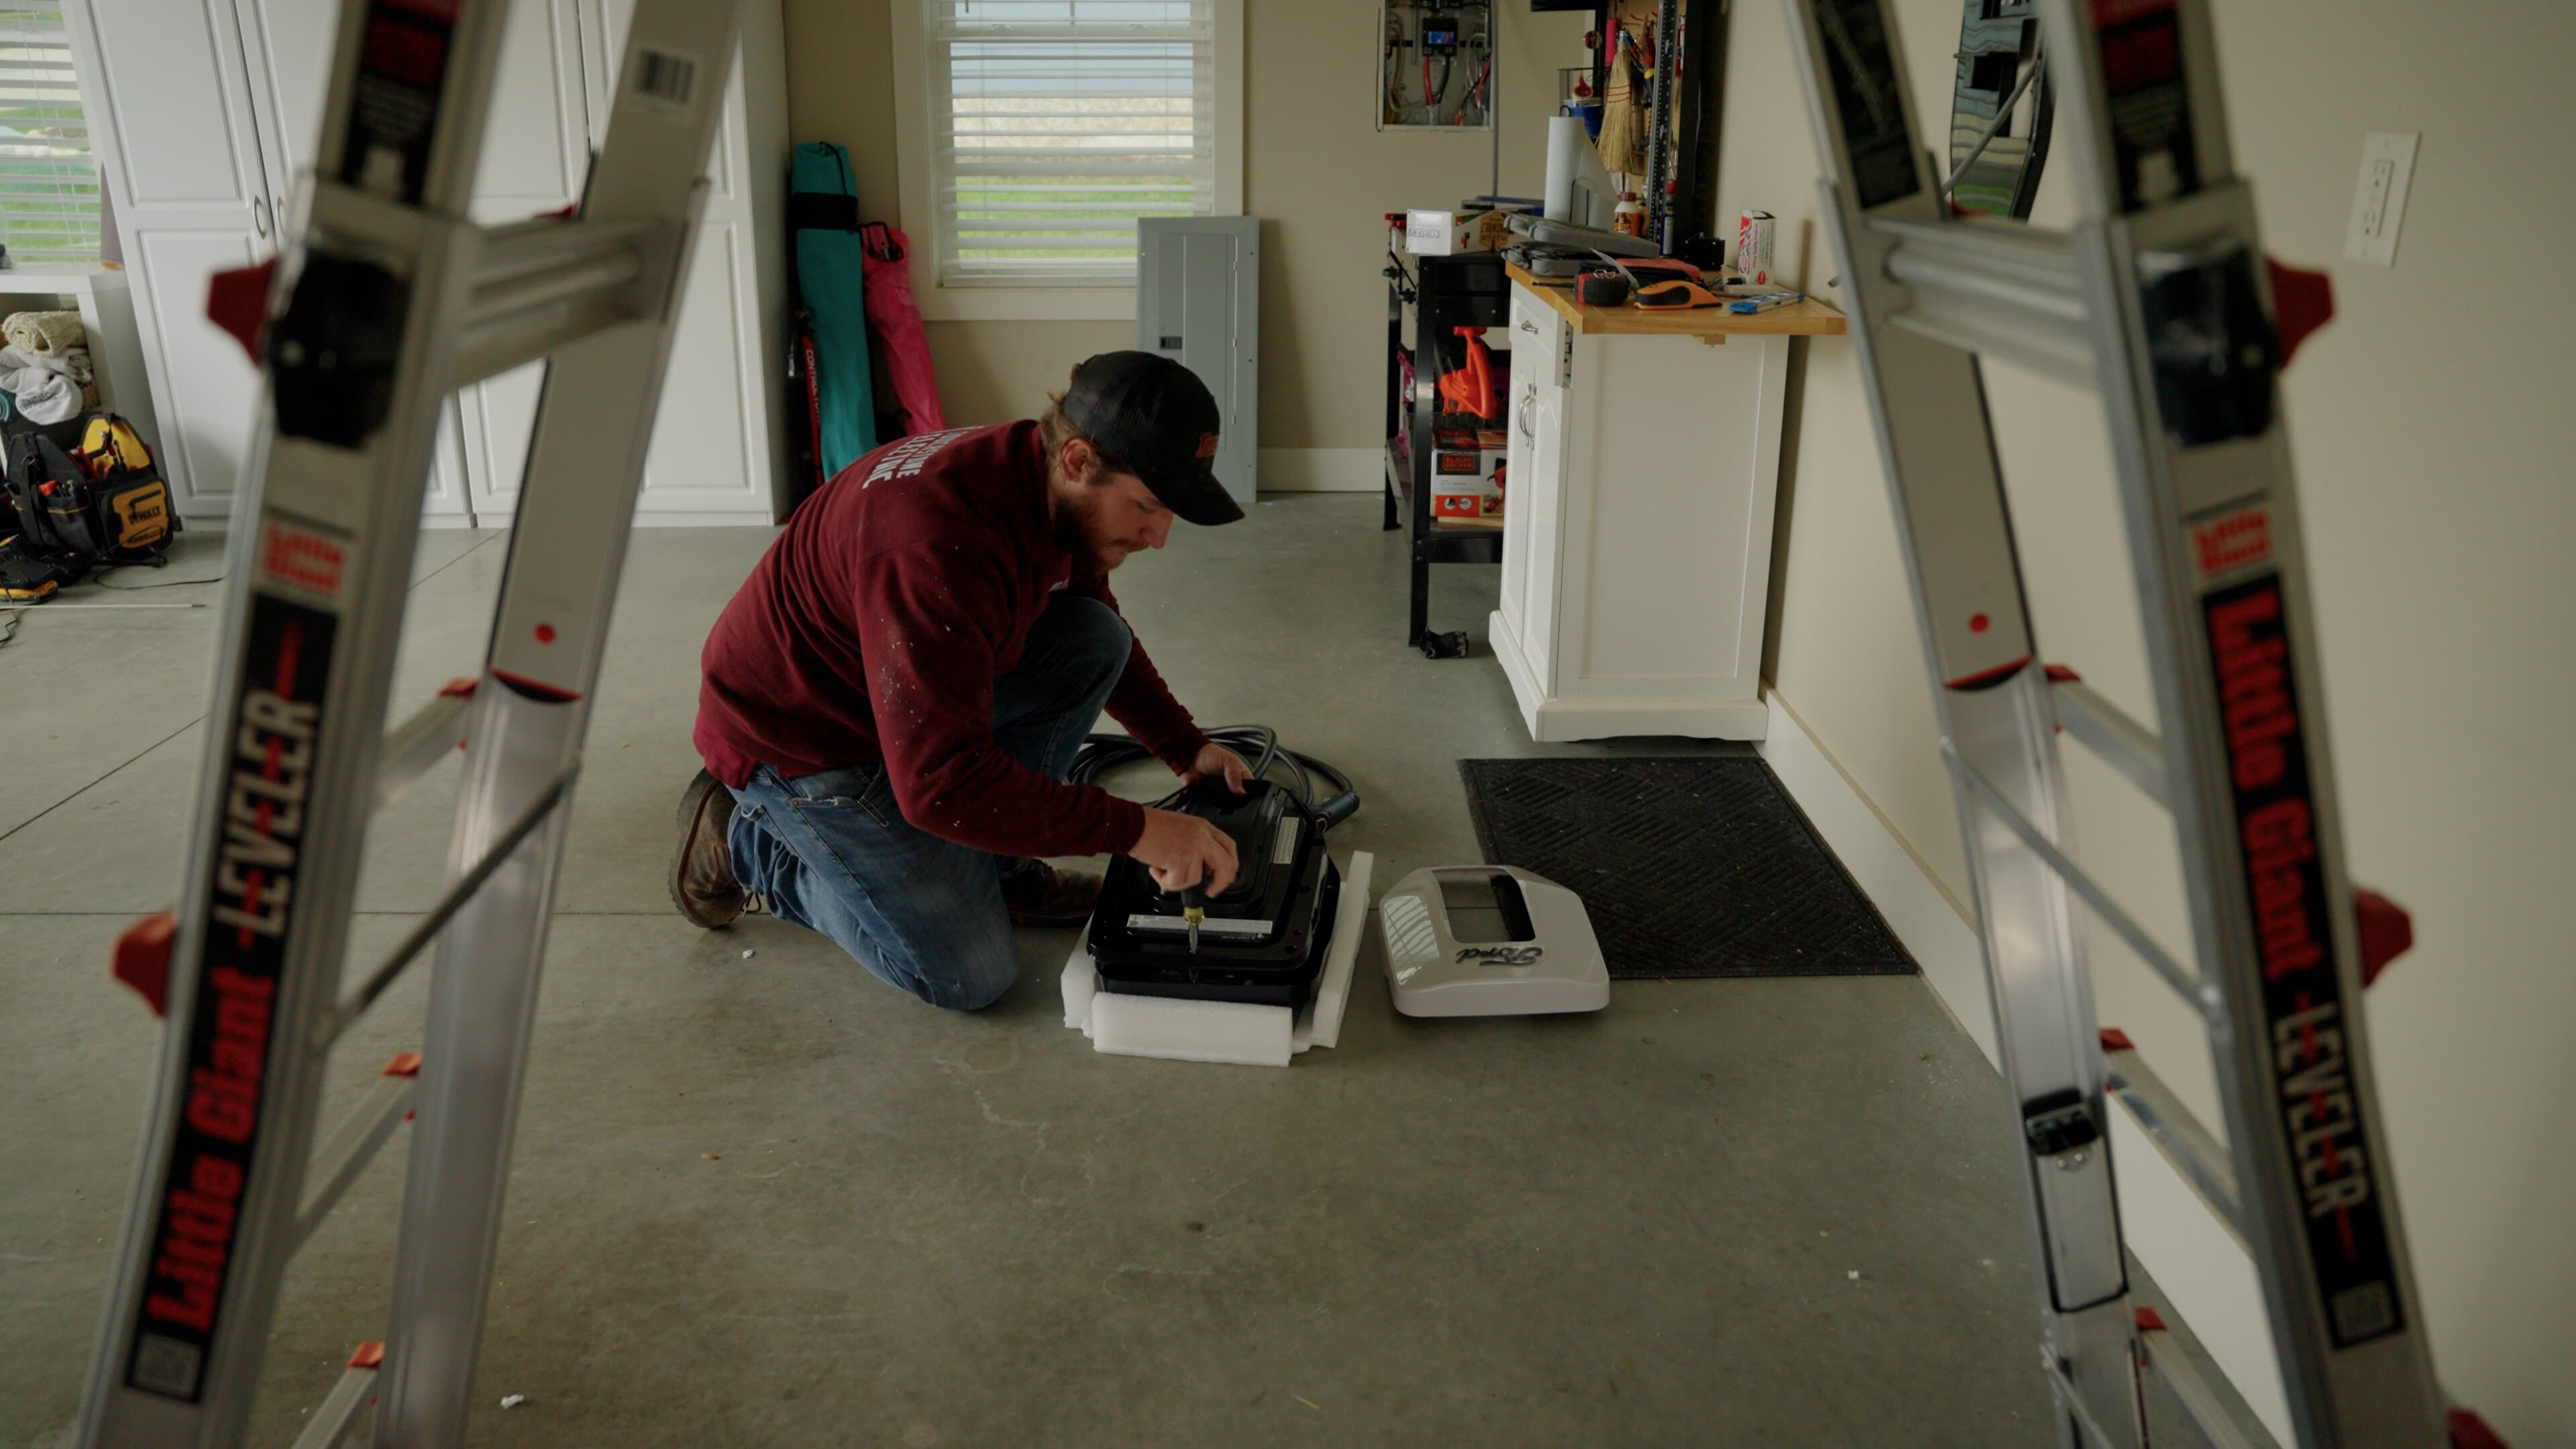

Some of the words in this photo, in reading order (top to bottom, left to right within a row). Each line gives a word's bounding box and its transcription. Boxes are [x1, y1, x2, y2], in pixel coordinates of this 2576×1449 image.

[2208, 588, 2298, 792] Little
[215, 689, 320, 940] LEVELER
[2243, 796, 2324, 981] Giant
[1455, 947, 1543, 967] Ford
[186, 966, 276, 1144] Giant
[2273, 1002, 2371, 1218] LEVELER
[146, 1154, 244, 1332] Little
